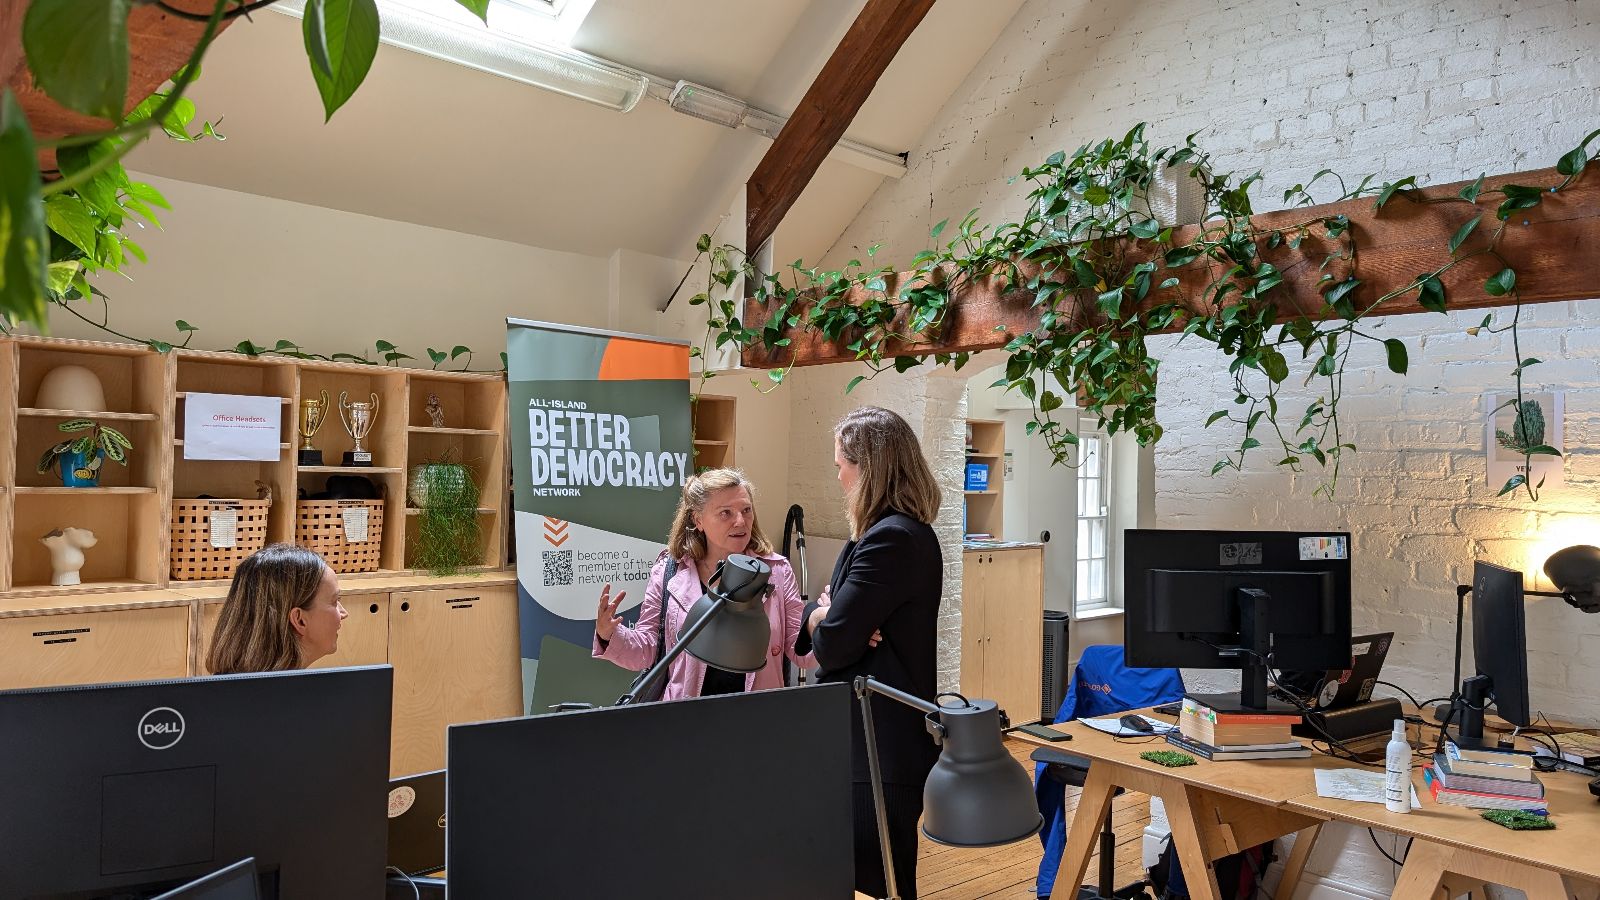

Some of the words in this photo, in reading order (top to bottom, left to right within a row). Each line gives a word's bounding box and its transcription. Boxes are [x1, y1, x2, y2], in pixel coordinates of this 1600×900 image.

[529, 398, 587, 410] ALL-ISLAND
[529, 408, 631, 450] BETTER
[531, 447, 687, 486] DEMOCRACY
[533, 487, 581, 497] NETWORK
[577, 550, 620, 561] become
[622, 550, 629, 559] a
[578, 560, 621, 573] member
[623, 559, 634, 570] of
[636, 558, 653, 569] the
[578, 572, 622, 585] network
[144, 722, 180, 735] DELL
